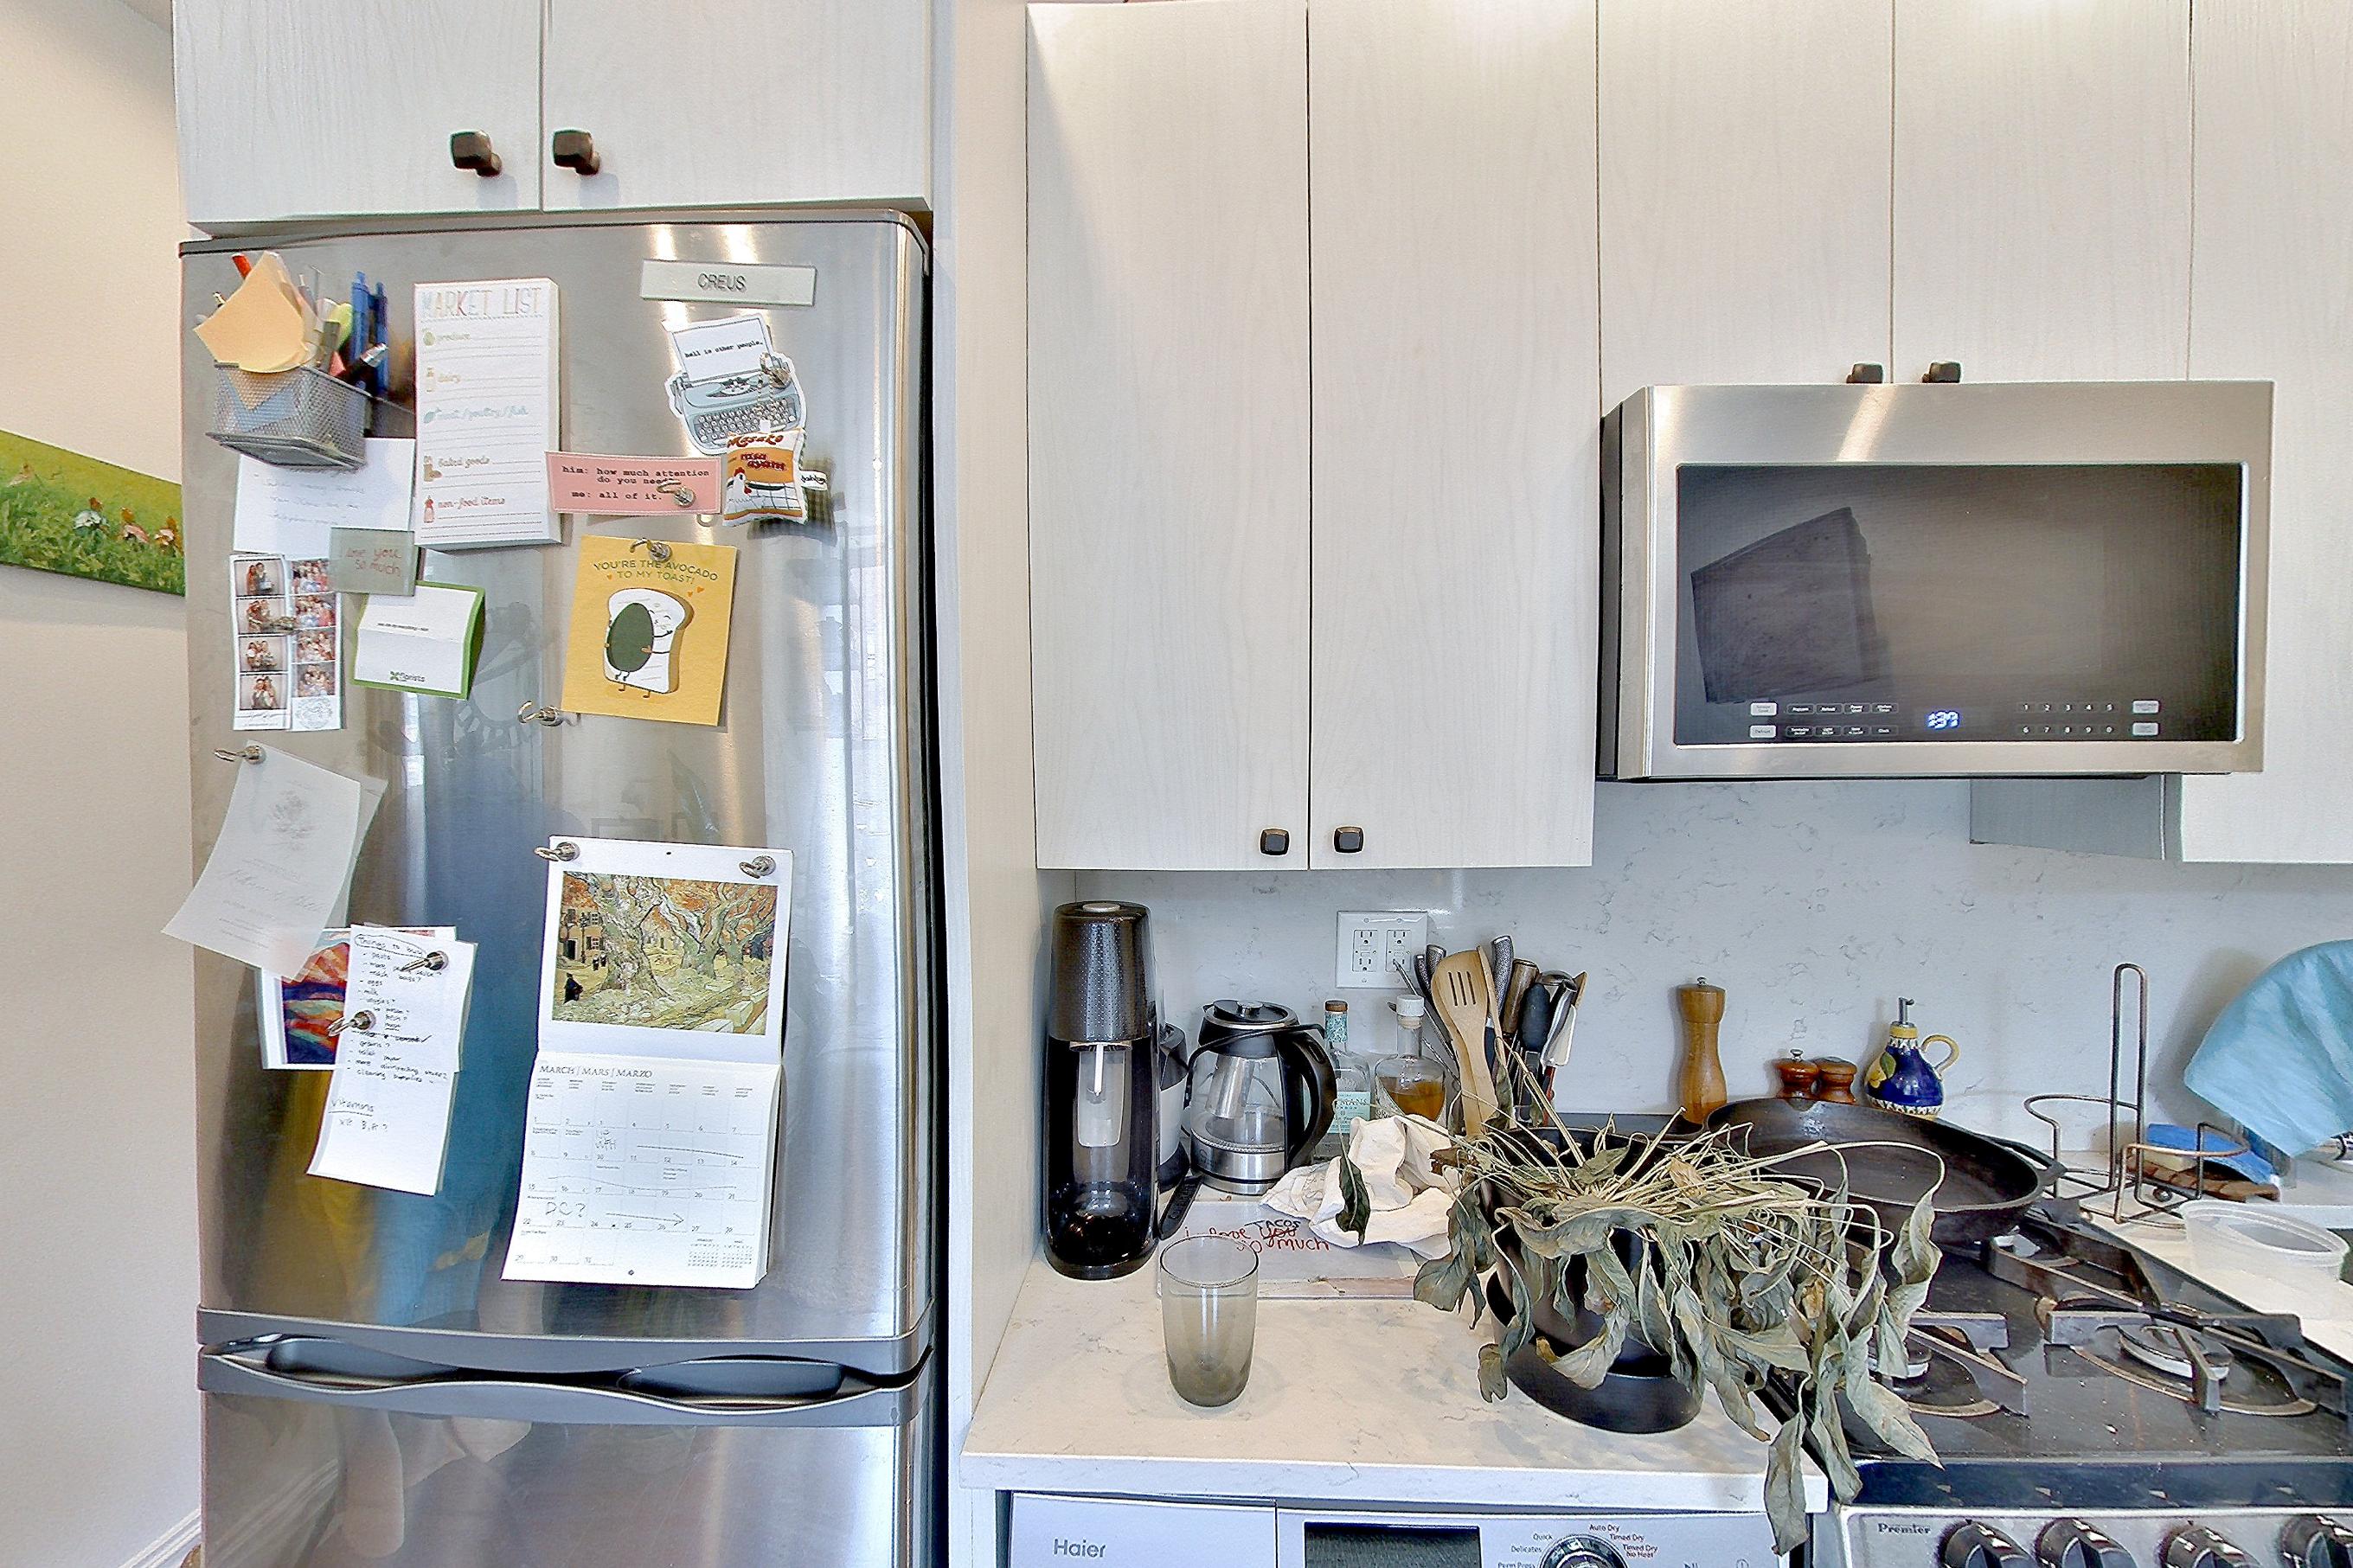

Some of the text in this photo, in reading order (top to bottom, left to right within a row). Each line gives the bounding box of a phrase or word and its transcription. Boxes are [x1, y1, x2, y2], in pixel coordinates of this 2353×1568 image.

[697, 273, 747, 292] CREUS
[421, 286, 542, 317] MARKET LIST
[715, 345, 734, 354] other
[737, 340, 764, 349] people.
[593, 560, 718, 580] YOU'RE THE AVOCADO
[657, 571, 696, 585] TOAST!
[539, 1066, 653, 1078] MARCH MARS MARZO
[1245, 1219, 1301, 1230] TACOS
[1277, 1237, 1330, 1251] much
[1607, 1524, 1620, 1533] Dry
[1877, 1522, 1932, 1534] Premier
[1632, 1533, 1645, 1542] Dry
[1053, 1538, 1106, 1558] Haier
[1510, 1545, 1542, 1553] Delicates
[1645, 1545, 1658, 1553] Dry
